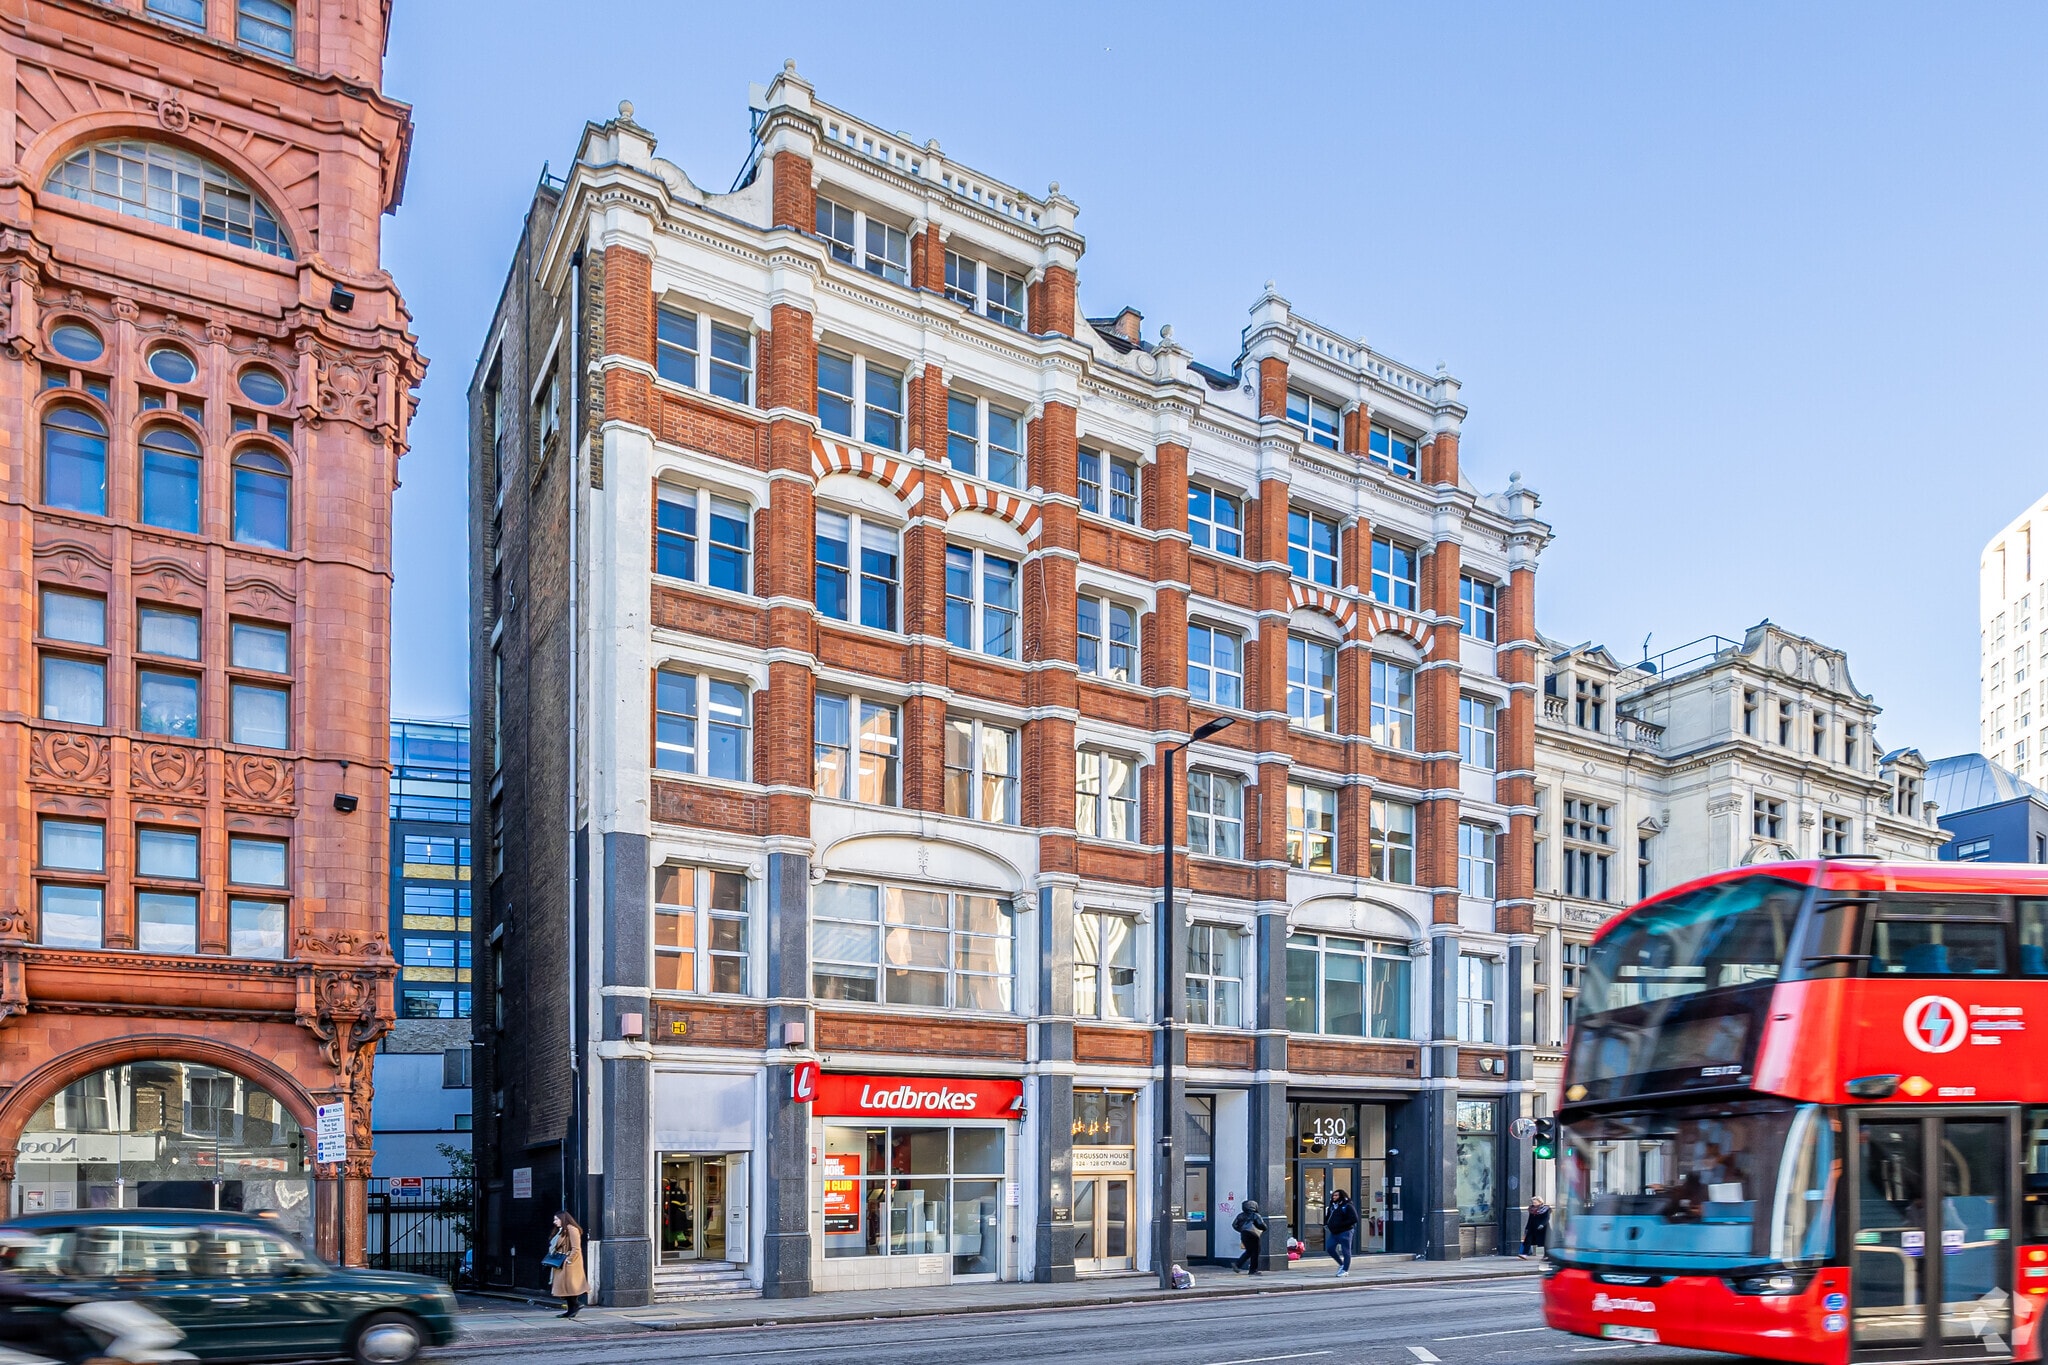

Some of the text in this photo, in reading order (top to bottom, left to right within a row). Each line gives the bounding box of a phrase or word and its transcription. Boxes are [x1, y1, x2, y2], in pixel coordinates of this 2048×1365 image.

[860, 1084, 978, 1110] Ladbrokes
[1313, 1117, 1346, 1137] 130
[1313, 1136, 1346, 1146] City Road
[831, 1180, 853, 1191] CLUB
